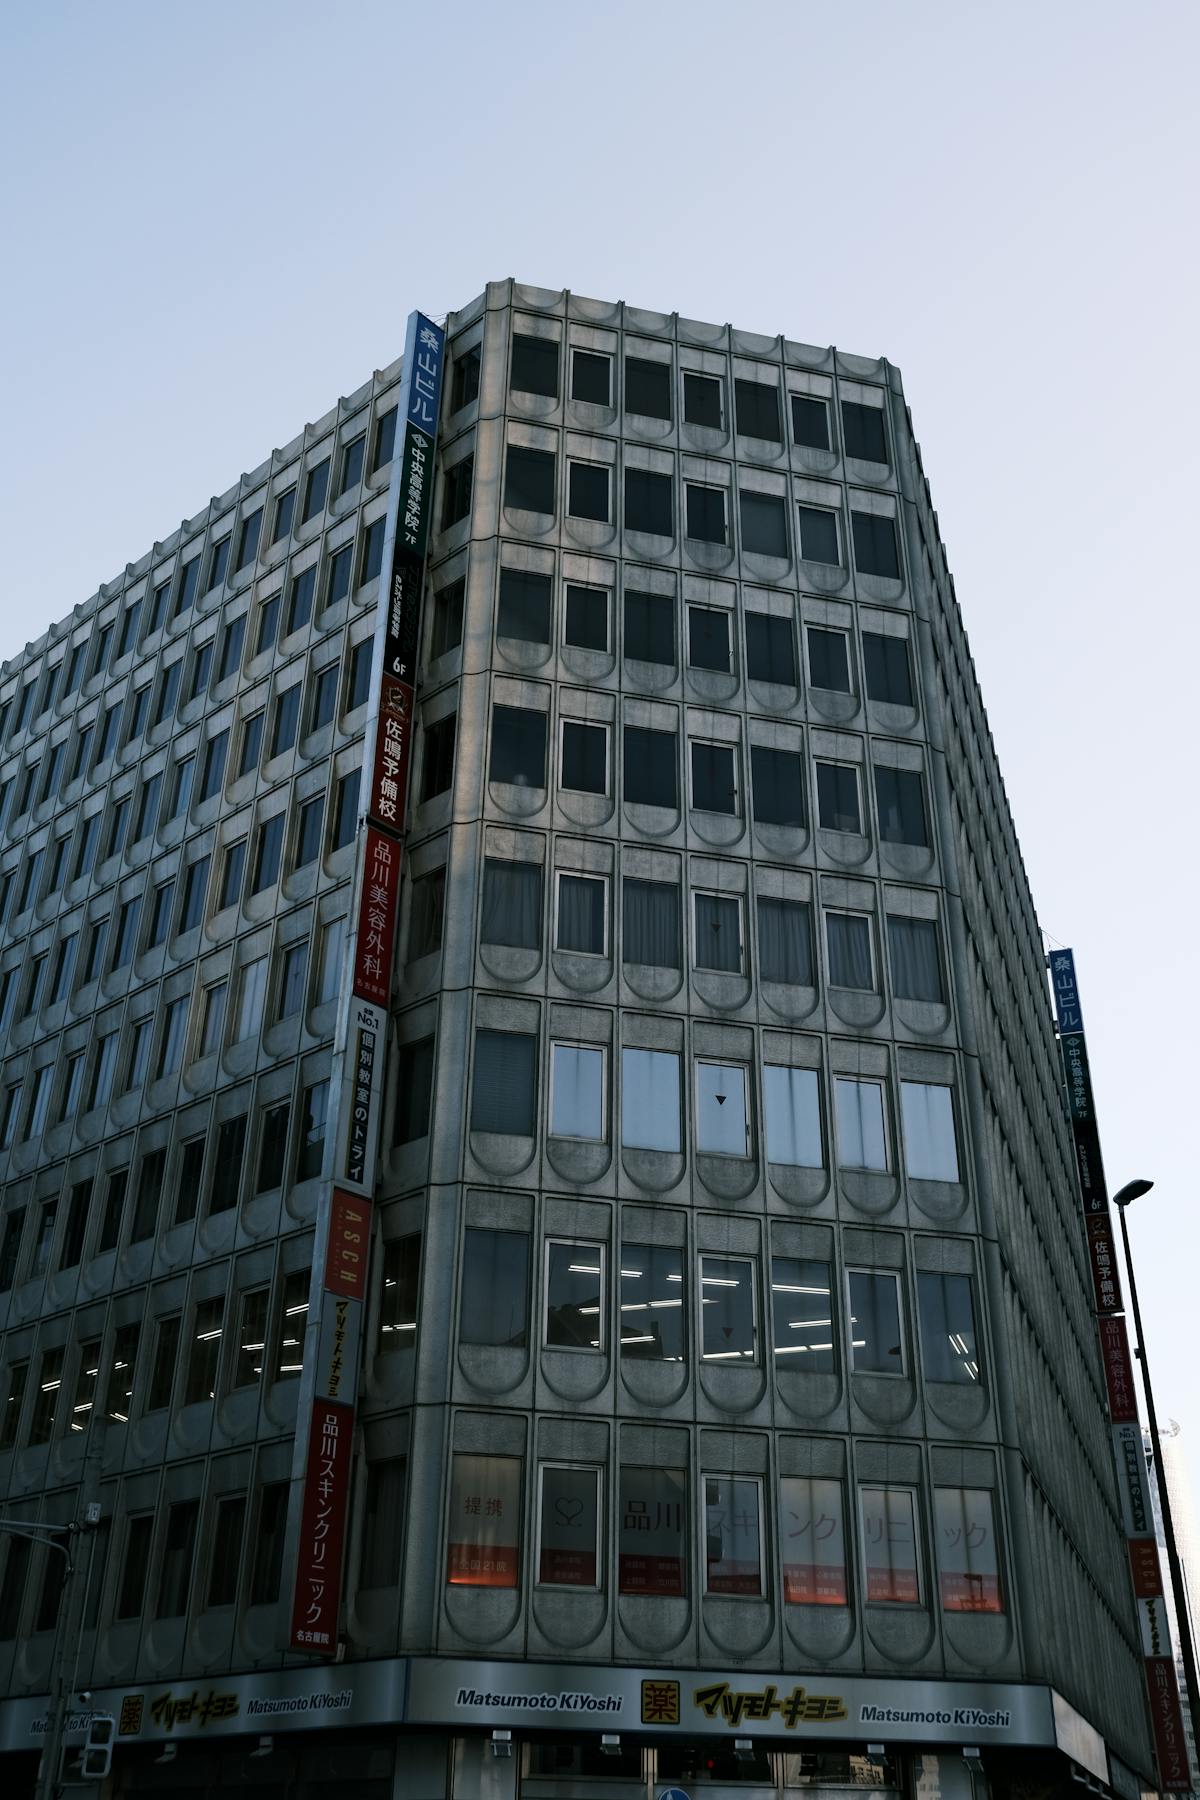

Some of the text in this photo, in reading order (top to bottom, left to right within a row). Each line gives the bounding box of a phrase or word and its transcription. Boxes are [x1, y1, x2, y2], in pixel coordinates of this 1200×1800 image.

[412, 327, 439, 422] 桑山ビル
[404, 447, 426, 532] 中央高等学院
[404, 531, 417, 545] 7F
[392, 656, 407, 676] 6F
[378, 718, 403, 822] 佐鳴予備校
[362, 840, 392, 980] 品川美容外科
[1054, 956, 1079, 1028] 桑山ビル
[357, 1011, 379, 1029] No.1
[350, 1031, 375, 1180] 個別教室のトライ
[1091, 1197, 1103, 1210] 6F
[340, 1209, 363, 1283] ASCH
[1094, 1241, 1116, 1307] 佐鳴予備校
[1105, 1320, 1130, 1408] 品川美容外科
[306, 1414, 339, 1625] 品川スキンクリニック
[295, 1630, 330, 1645] 名古屋院
[121, 1698, 141, 1732] 薬
[151, 1691, 240, 1732] マツモトキヨシ
[247, 1691, 353, 1716] Matsumoto KiYoshi
[457, 1689, 622, 1712] Matsumoto KiYoshi
[645, 1684, 677, 1721] 薬
[694, 1683, 847, 1728] マツモトキヨシ
[861, 1706, 1010, 1727] Matsumoto KiYoshi
